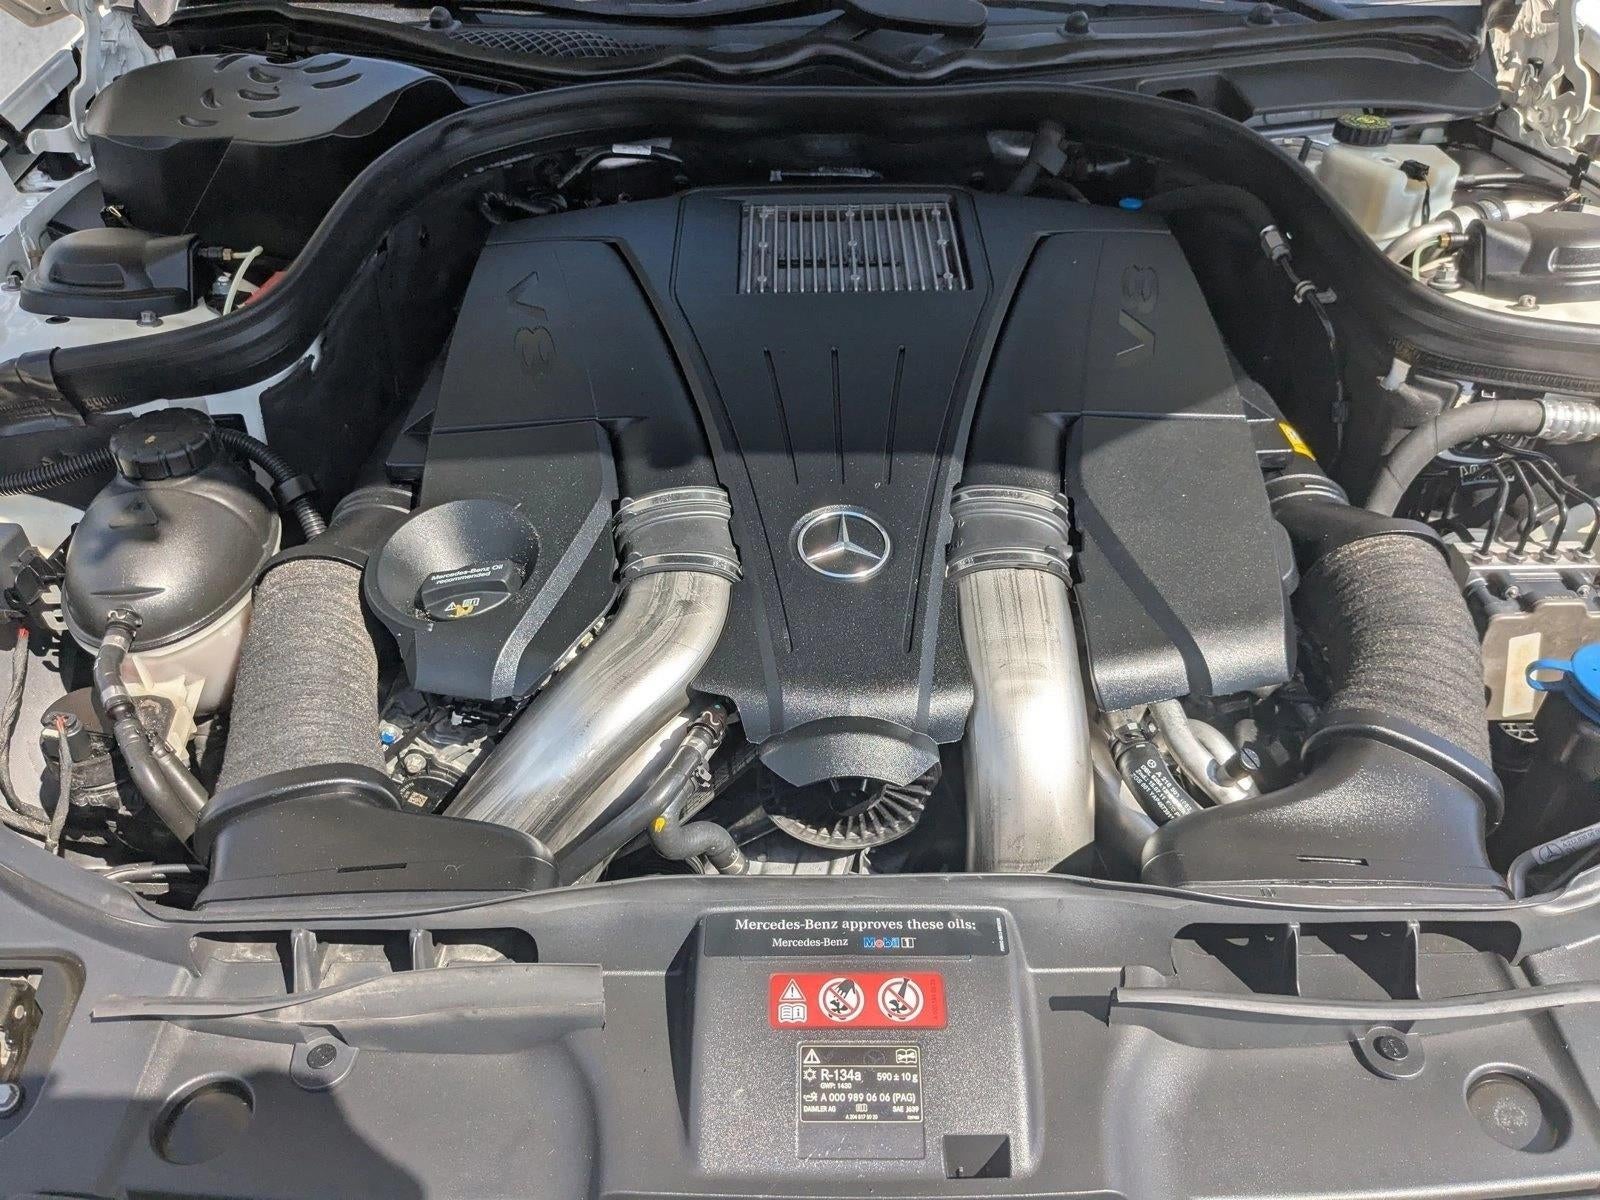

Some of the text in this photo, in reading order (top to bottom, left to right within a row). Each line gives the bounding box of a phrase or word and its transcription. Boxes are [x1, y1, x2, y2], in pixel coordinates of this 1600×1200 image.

[735, 918, 976, 932] Mercedes-Benz approves these oils:
[772, 938, 848, 947] Mercedes-Benz
[863, 937, 900, 948] Mobil
[820, 1069, 861, 1081] R-134a
[877, 1073, 893, 1081] 590
[901, 1073, 911, 1081] 10
[912, 1074, 919, 1083] g
[820, 1093, 916, 1104] A 000 989 06 06 (PAG)
[892, 1105, 904, 1113] SAE
